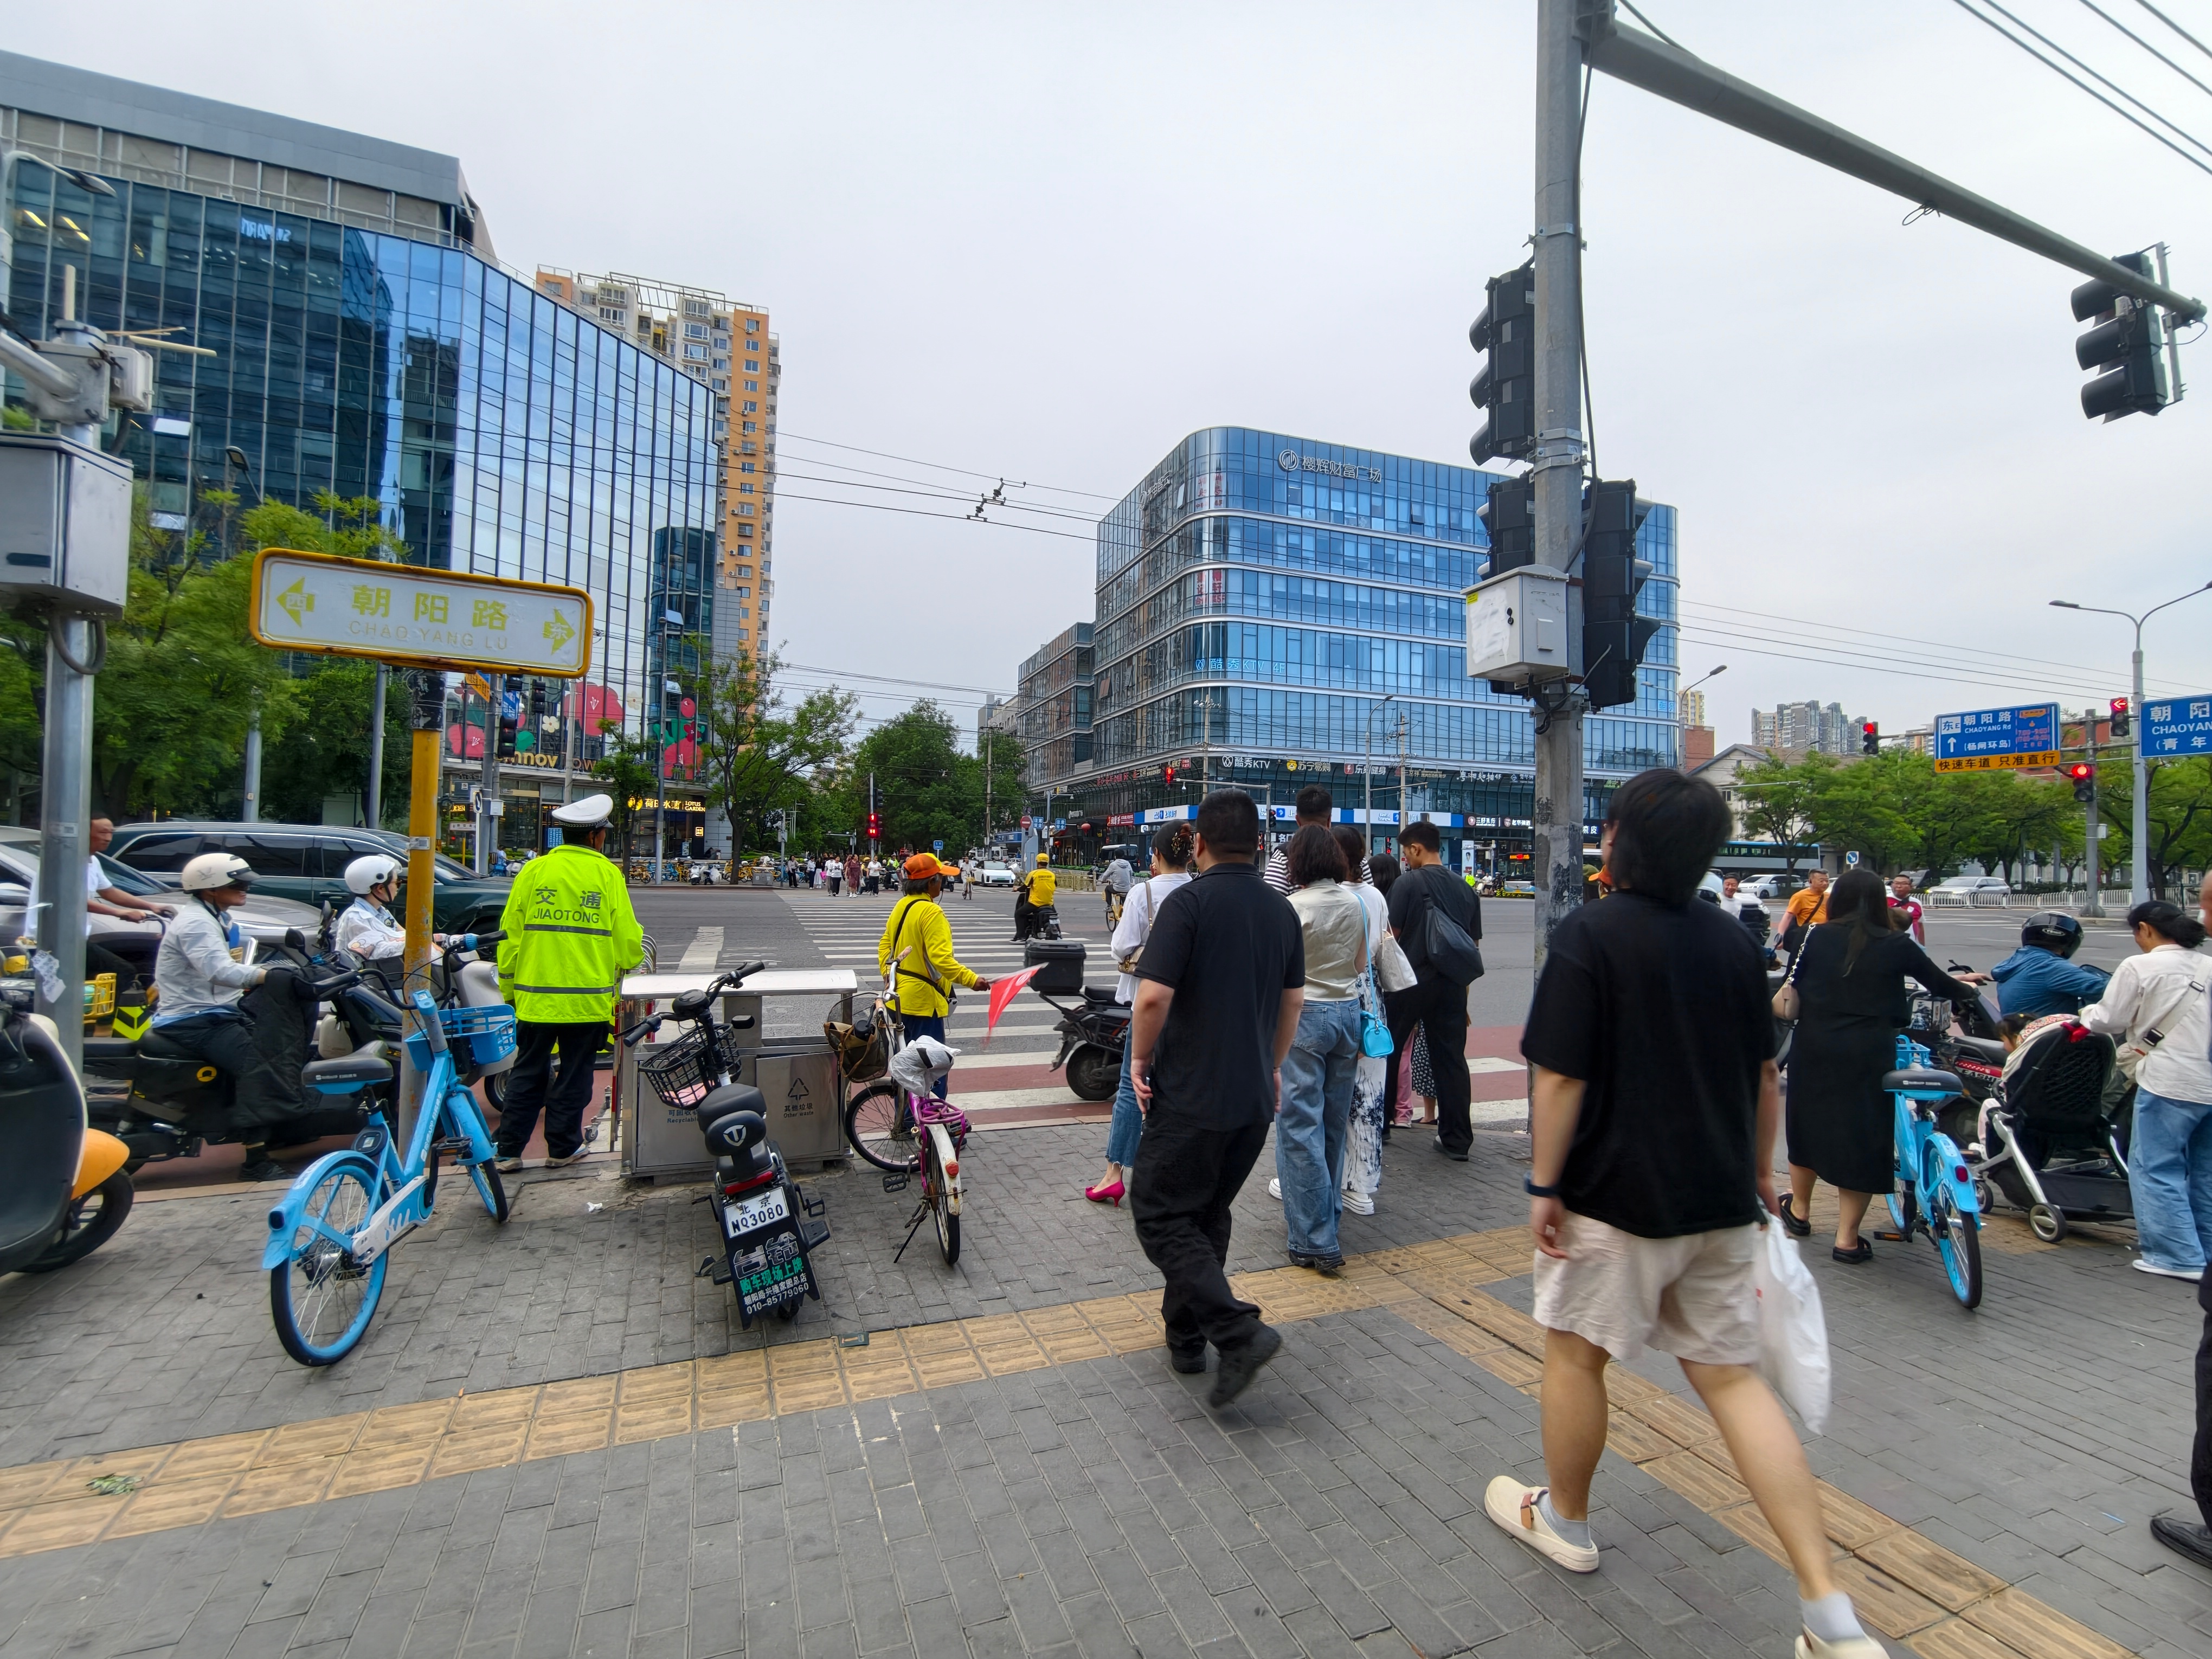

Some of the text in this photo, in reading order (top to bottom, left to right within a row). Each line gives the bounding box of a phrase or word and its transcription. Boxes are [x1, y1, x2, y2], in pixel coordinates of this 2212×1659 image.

[1302, 455, 1381, 483] 樱辉财富广场
[286, 593, 306, 611] 西
[352, 584, 509, 631] 朝阳路
[349, 621, 508, 650] CHAO YANG LU
[1210, 658, 1285, 673] 酷秀KTV 4F
[1963, 711, 2011, 725] 朝阳路
[2150, 702, 2210, 722] 朝阳
[1943, 721, 1953, 731] 东
[1965, 725, 2001, 734] CHAOYANG
[1234, 757, 1270, 769] 酷秀KTV
[1298, 761, 1331, 772] 苏宁易购
[1939, 753, 2055, 770] 快速车道 只准直行
[535, 886, 602, 910] 交通
[533, 908, 600, 923] JIAOTONG
[784, 1103, 813, 1112] 其他垃圾
[739, 1197, 771, 1215] 北京
[732, 1204, 783, 1233] NQ3080
[734, 1232, 800, 1279] 台铃
[740, 1257, 804, 1295] 购车现场上牌
[743, 1272, 807, 1306] 朝阳路兴隆家园总店
[746, 1283, 809, 1314] 010-85779060
